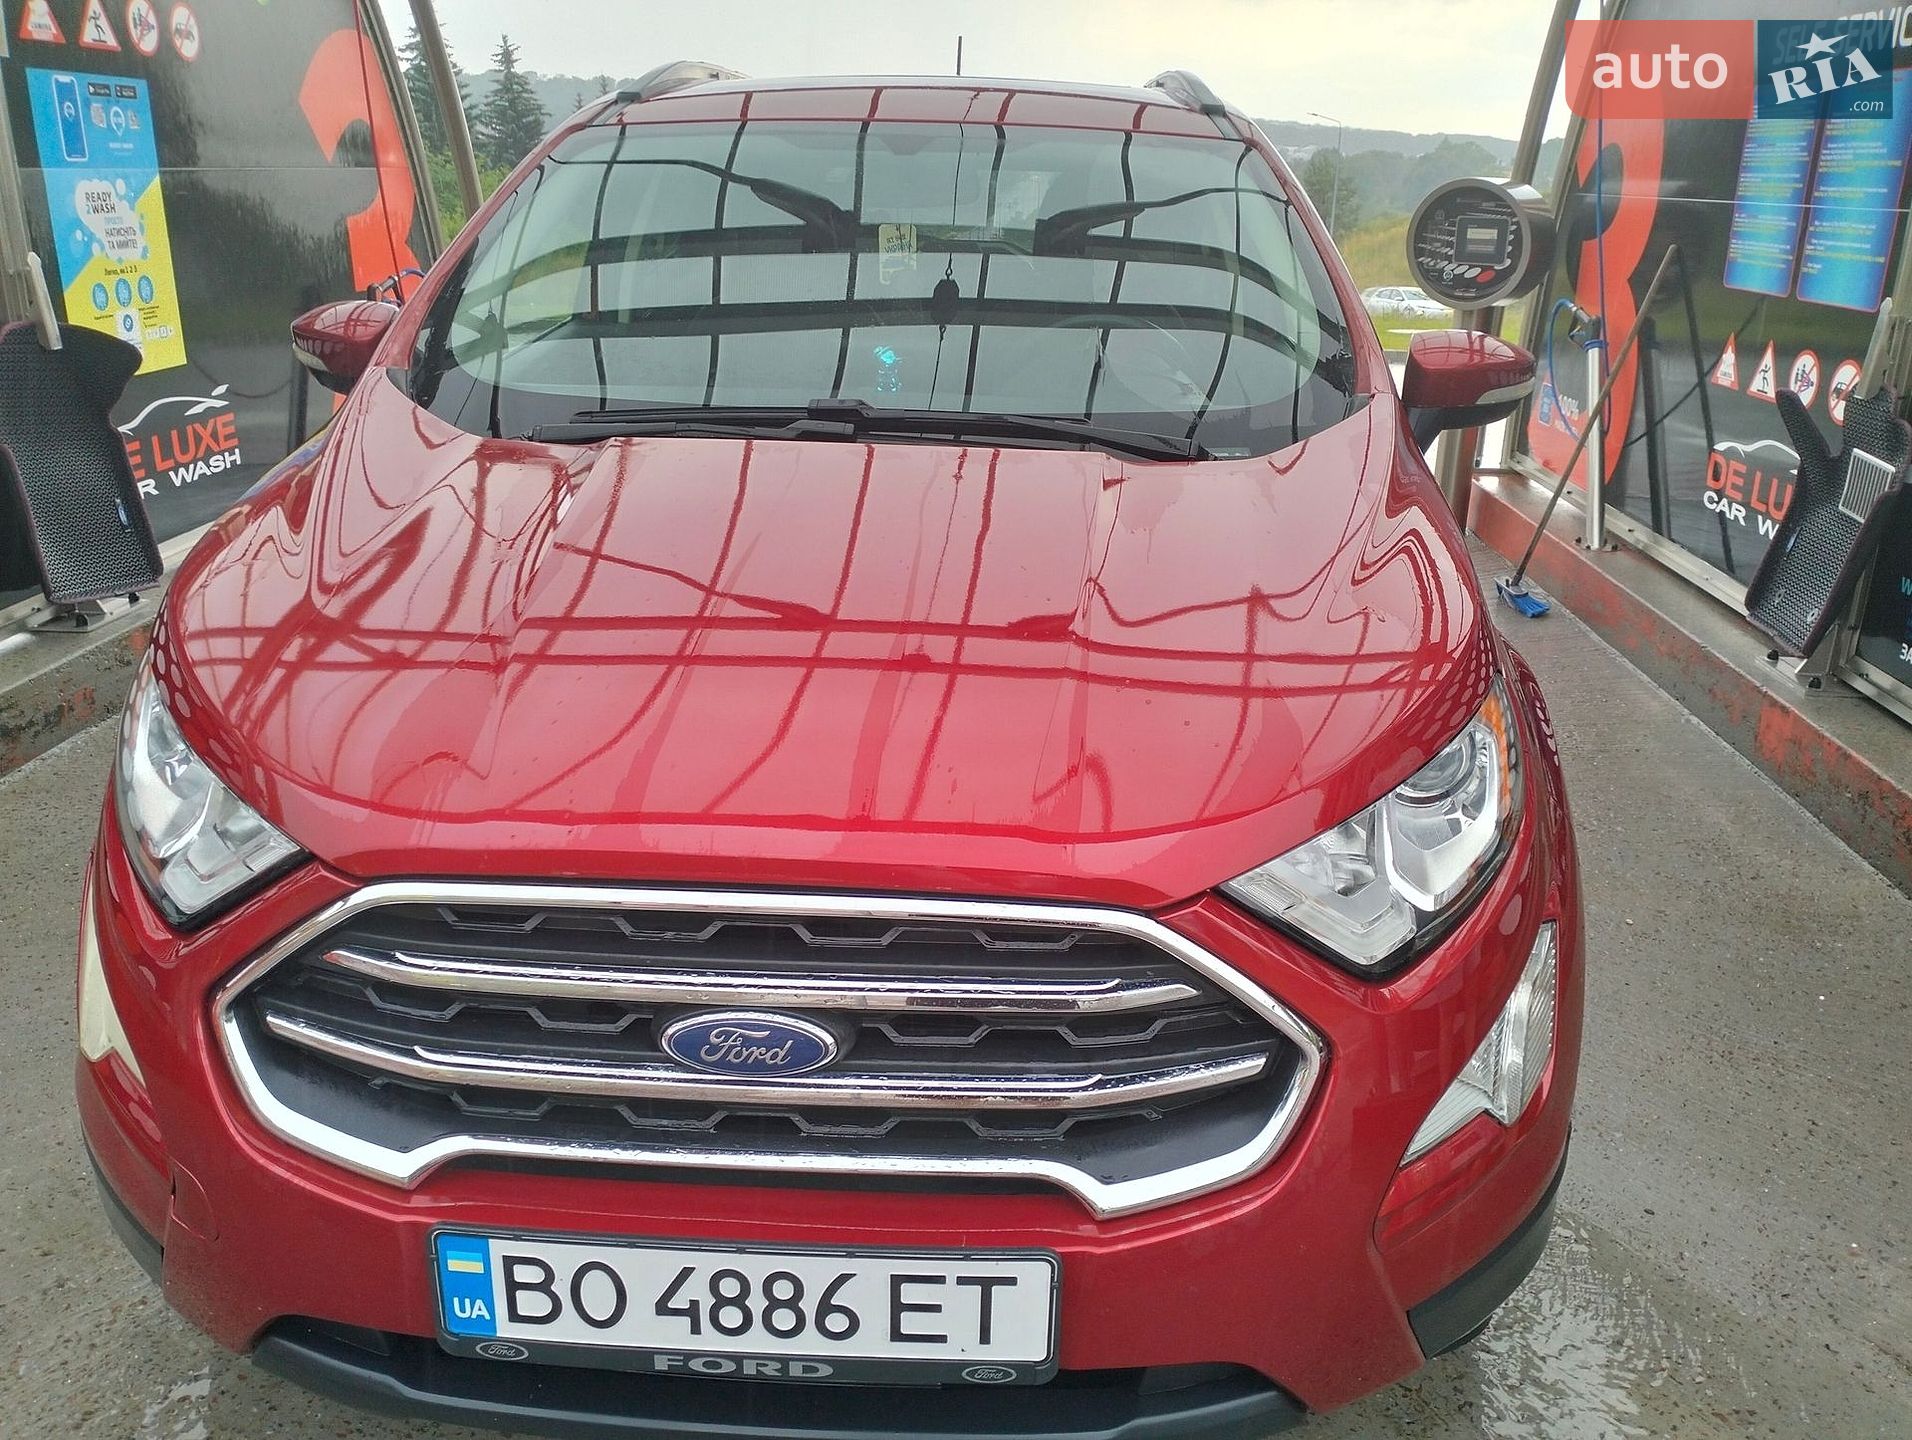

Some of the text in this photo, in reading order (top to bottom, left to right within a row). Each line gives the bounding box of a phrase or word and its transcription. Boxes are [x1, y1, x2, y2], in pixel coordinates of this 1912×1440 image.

[1833, 4, 1912, 55] SERVIC
[85, 192, 112, 202] READY
[126, 412, 239, 479] E LUXE
[168, 448, 241, 487] WASH
[1706, 451, 1793, 522] DE LU
[1703, 490, 1747, 526] CAR
[700, 1026, 794, 1065] Ford
[453, 1297, 491, 1321] UA
[501, 1254, 1018, 1345] BO 4886 ET
[487, 1343, 517, 1357] Ford
[653, 1354, 834, 1378] FORD
[973, 1367, 1005, 1380] Ford
